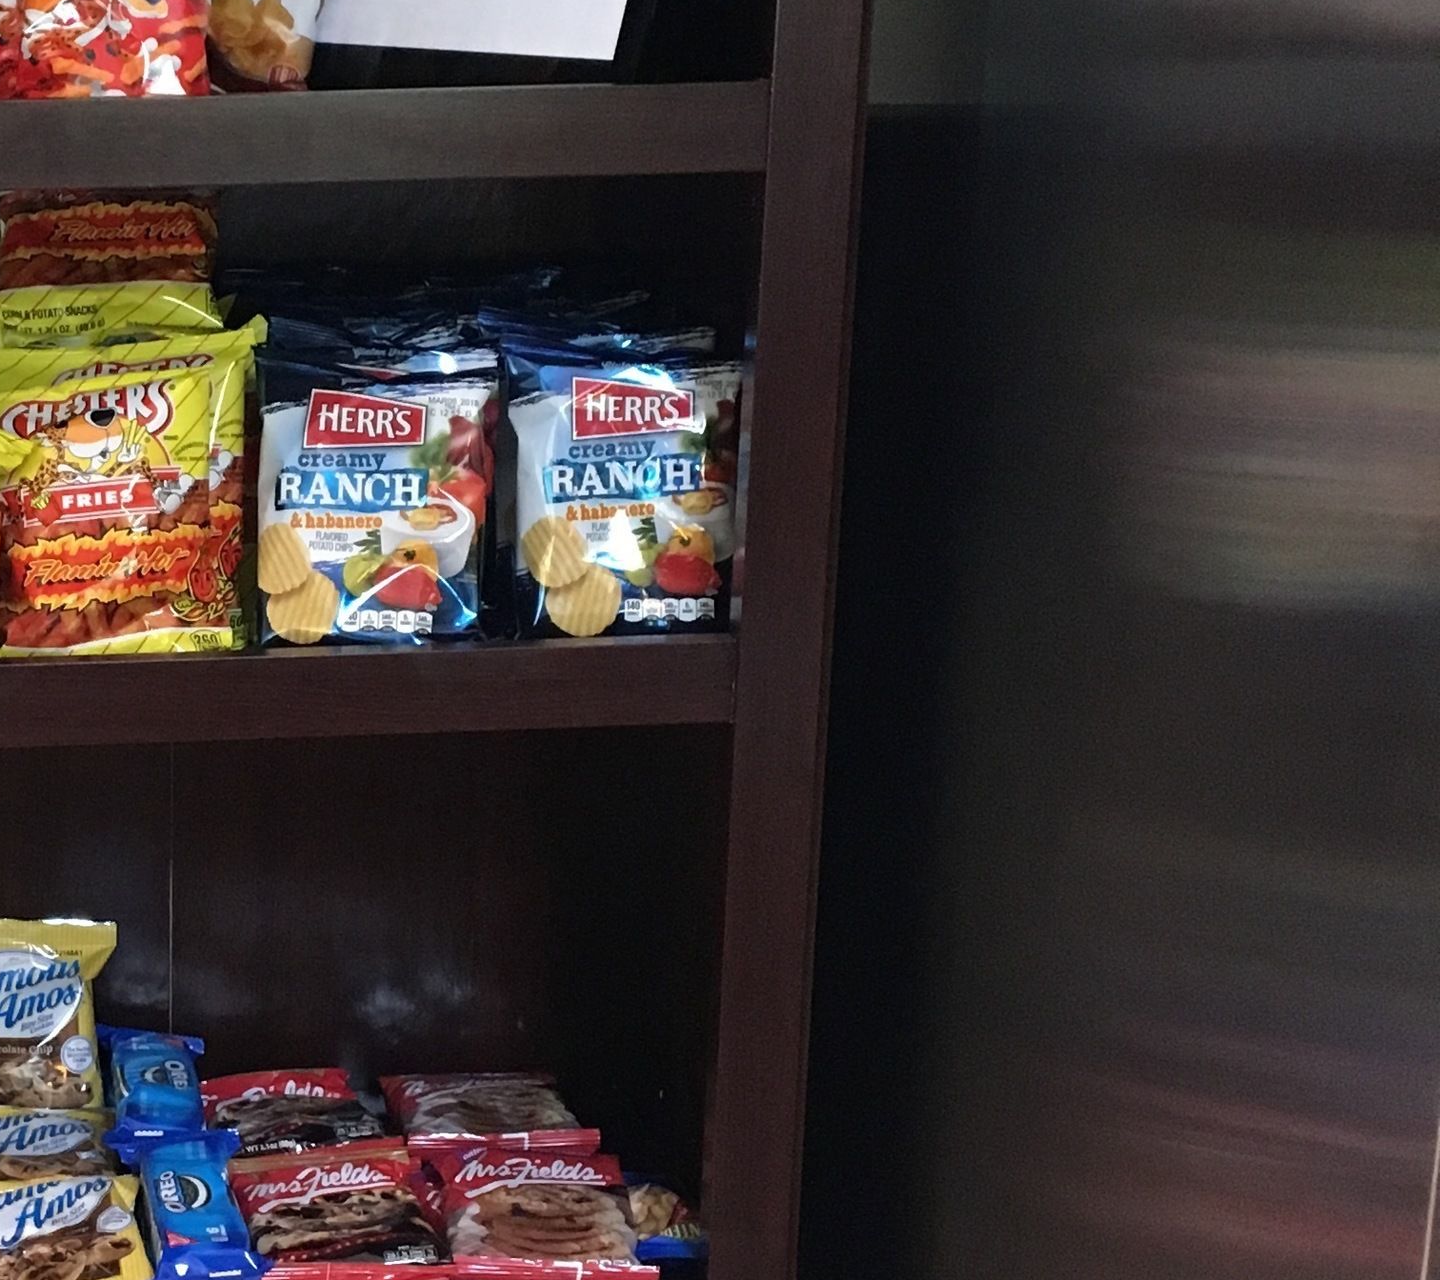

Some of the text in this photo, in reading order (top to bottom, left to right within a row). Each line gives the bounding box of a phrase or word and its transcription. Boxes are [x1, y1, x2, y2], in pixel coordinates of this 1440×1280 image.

[318, 403, 412, 438] HERR'S
[586, 394, 680, 425] HERR'S
[298, 452, 387, 471] creamy
[569, 439, 656, 461] creamy
[277, 470, 428, 508] RANCH
[550, 458, 703, 500] RANCH
[62, 491, 133, 510] FRIES
[566, 505, 578, 521] &
[290, 511, 383, 529] & habanero
[308, 541, 354, 553] POTATO CHIPS
[315, 530, 349, 542] FLAVORED
[295, 1162, 392, 1202] Fields
[508, 1158, 603, 1188] Fields
[157, 1171, 186, 1214] OREO
[1, 1178, 110, 1247] Amos
